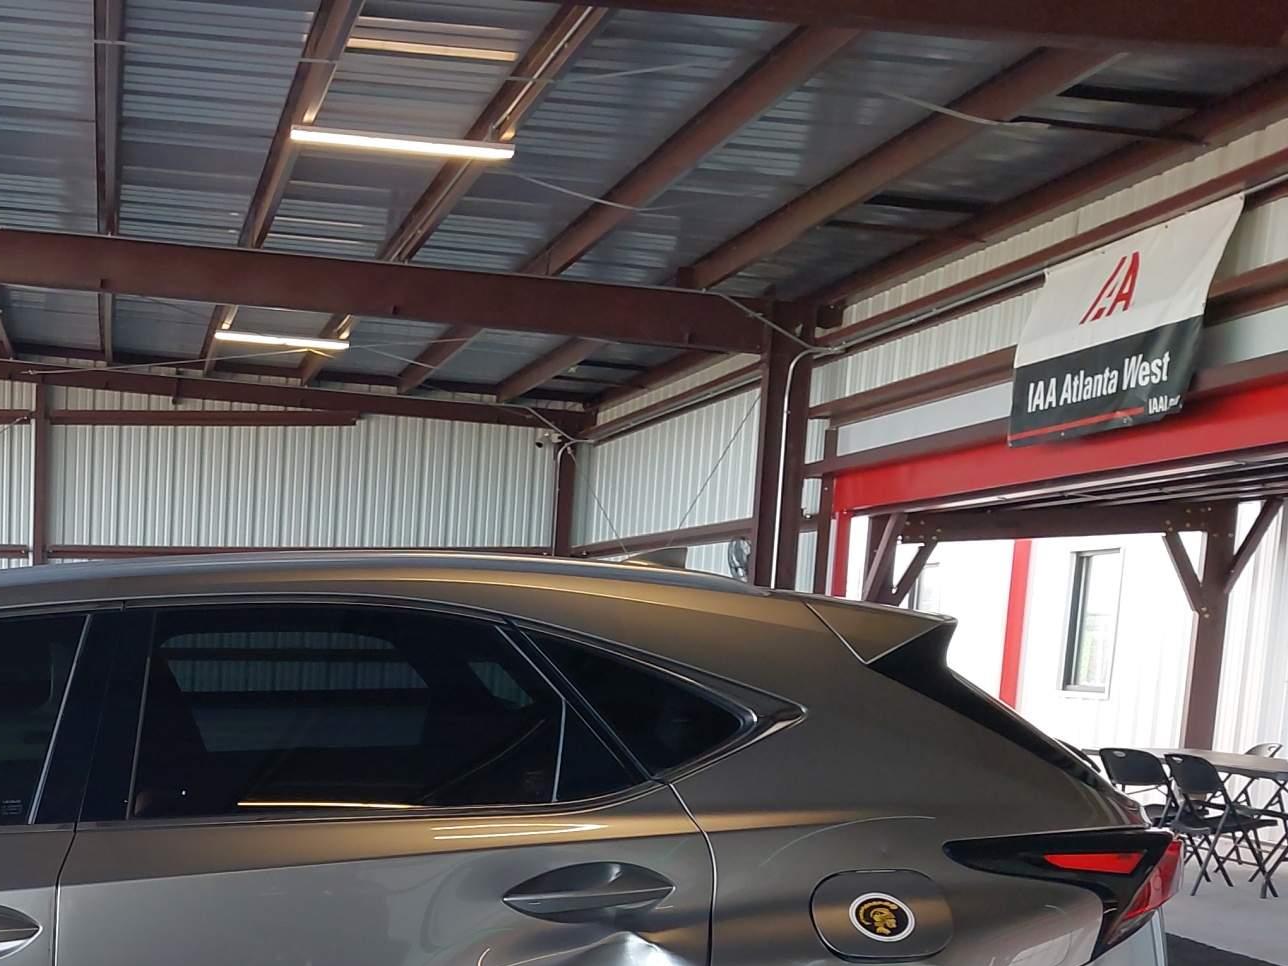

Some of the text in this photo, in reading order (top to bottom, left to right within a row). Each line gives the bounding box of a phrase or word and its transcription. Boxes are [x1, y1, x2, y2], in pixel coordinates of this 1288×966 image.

[1027, 351, 1171, 413] IAA Atlanta West
